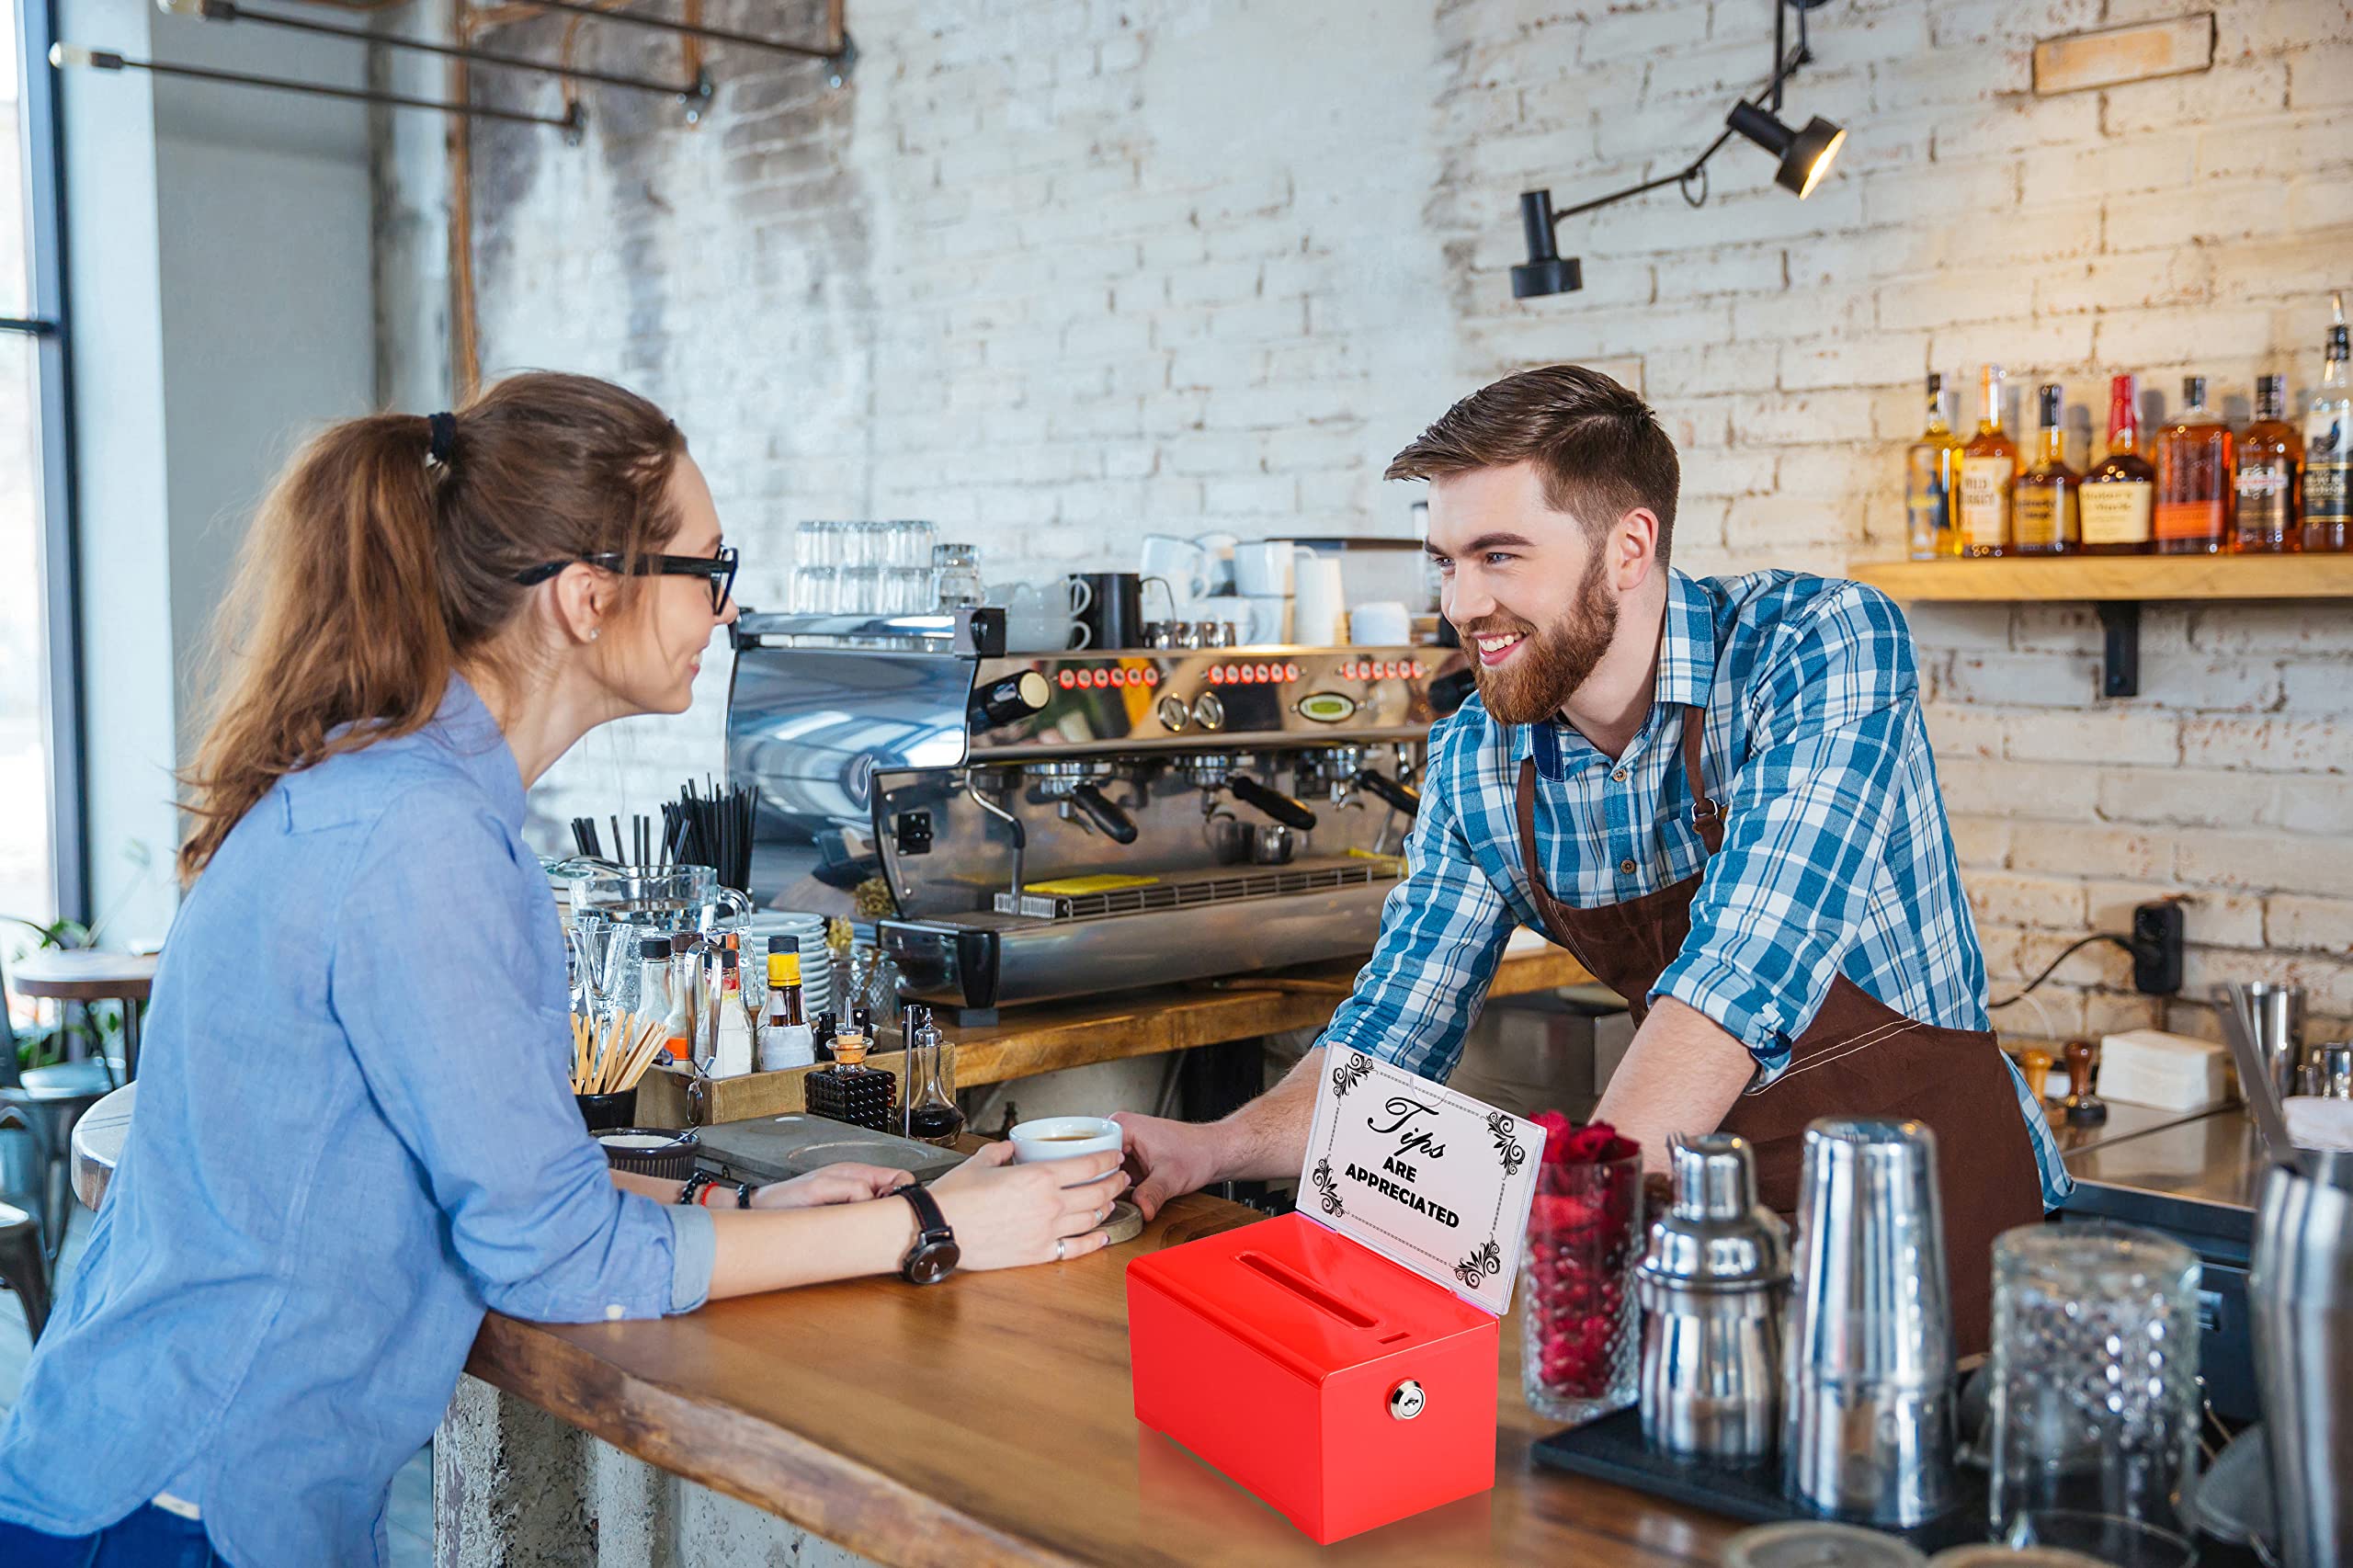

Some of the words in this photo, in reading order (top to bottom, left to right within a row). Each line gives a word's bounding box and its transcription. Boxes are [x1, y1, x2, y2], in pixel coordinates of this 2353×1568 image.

[1368, 1096, 1446, 1158] Tips
[1345, 1163, 1460, 1229] APPRECIATED
[1382, 1156, 1417, 1184] ARE
